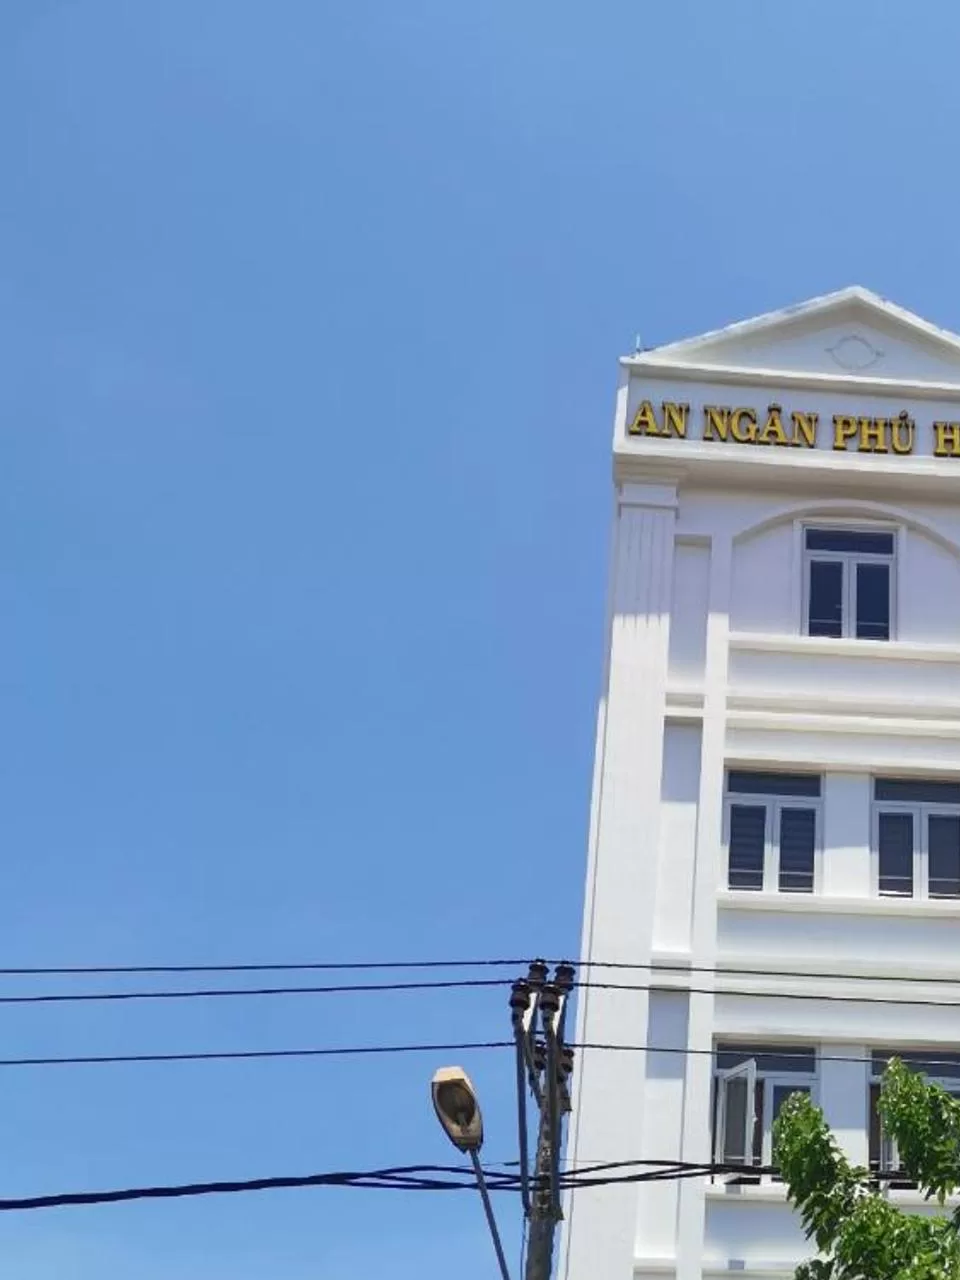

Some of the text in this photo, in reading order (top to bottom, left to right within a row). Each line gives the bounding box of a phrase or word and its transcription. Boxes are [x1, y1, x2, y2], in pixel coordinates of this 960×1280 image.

[628, 400, 690, 438] AN
[703, 402, 818, 449] NGÂN
[832, 409, 916, 455] PHÚ
